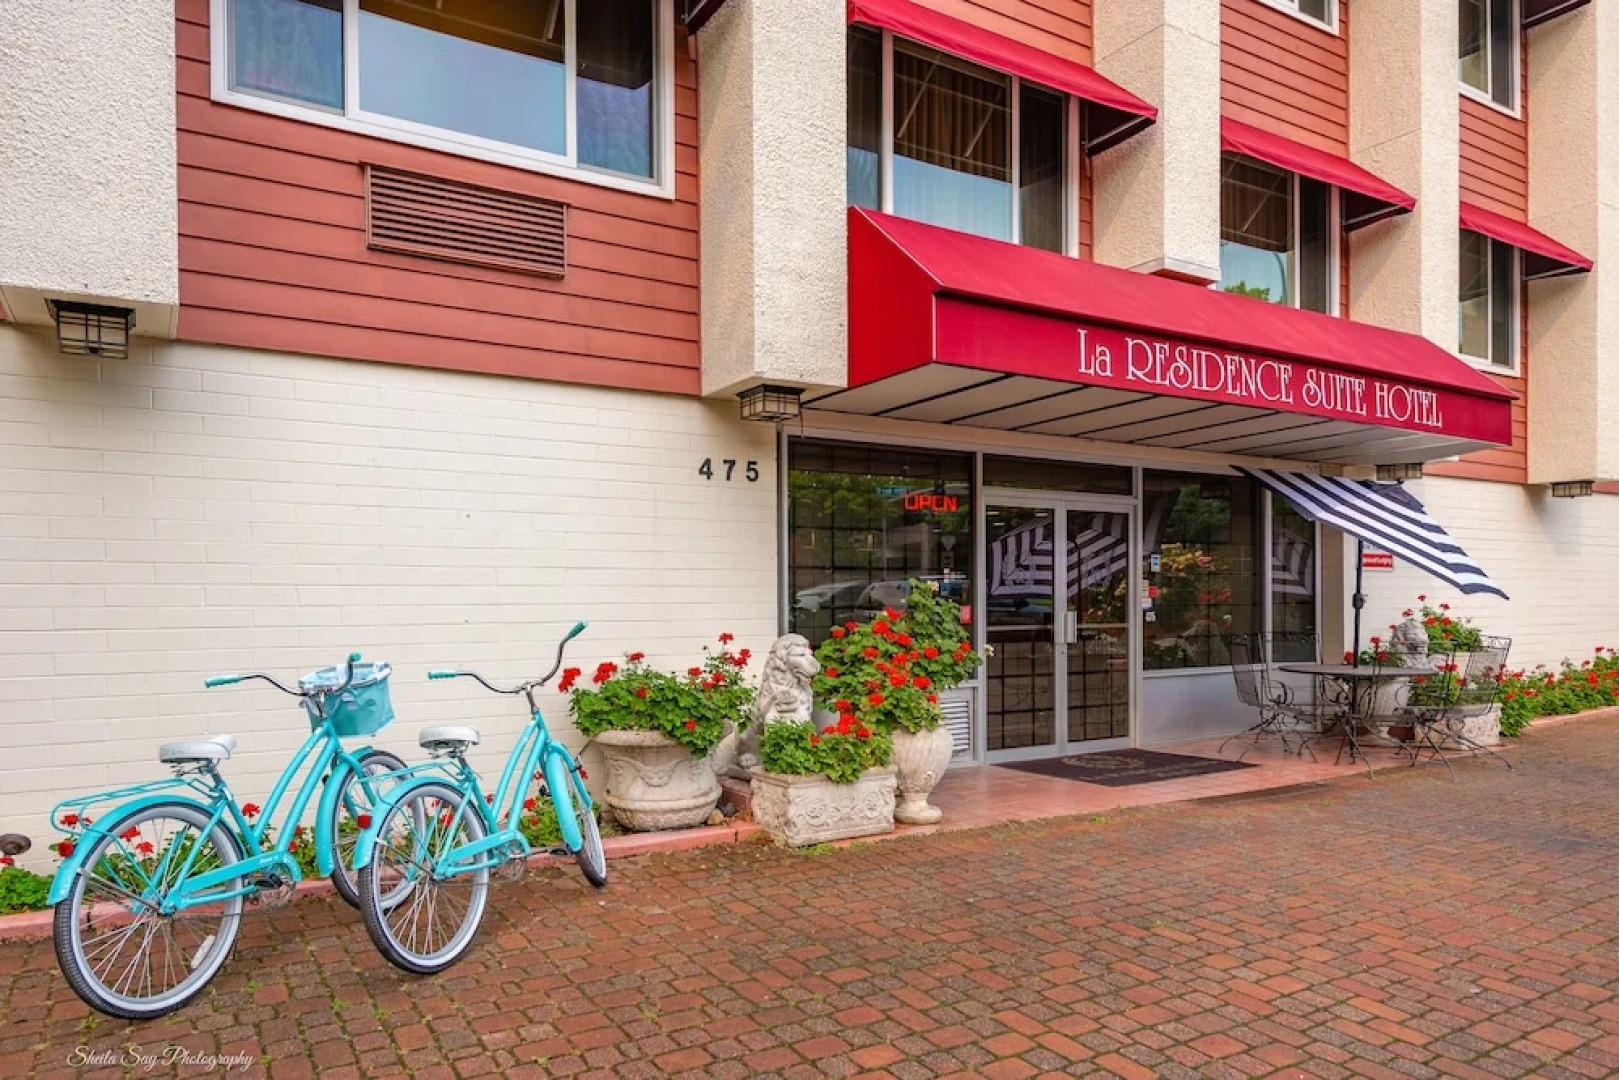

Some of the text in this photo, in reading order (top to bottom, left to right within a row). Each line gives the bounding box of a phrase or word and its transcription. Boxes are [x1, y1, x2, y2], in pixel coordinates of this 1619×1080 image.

[1077, 329, 1443, 428] La RESIDENCE SUITE HOTEL
[699, 457, 759, 482] 475
[904, 493, 958, 512] OPEN
